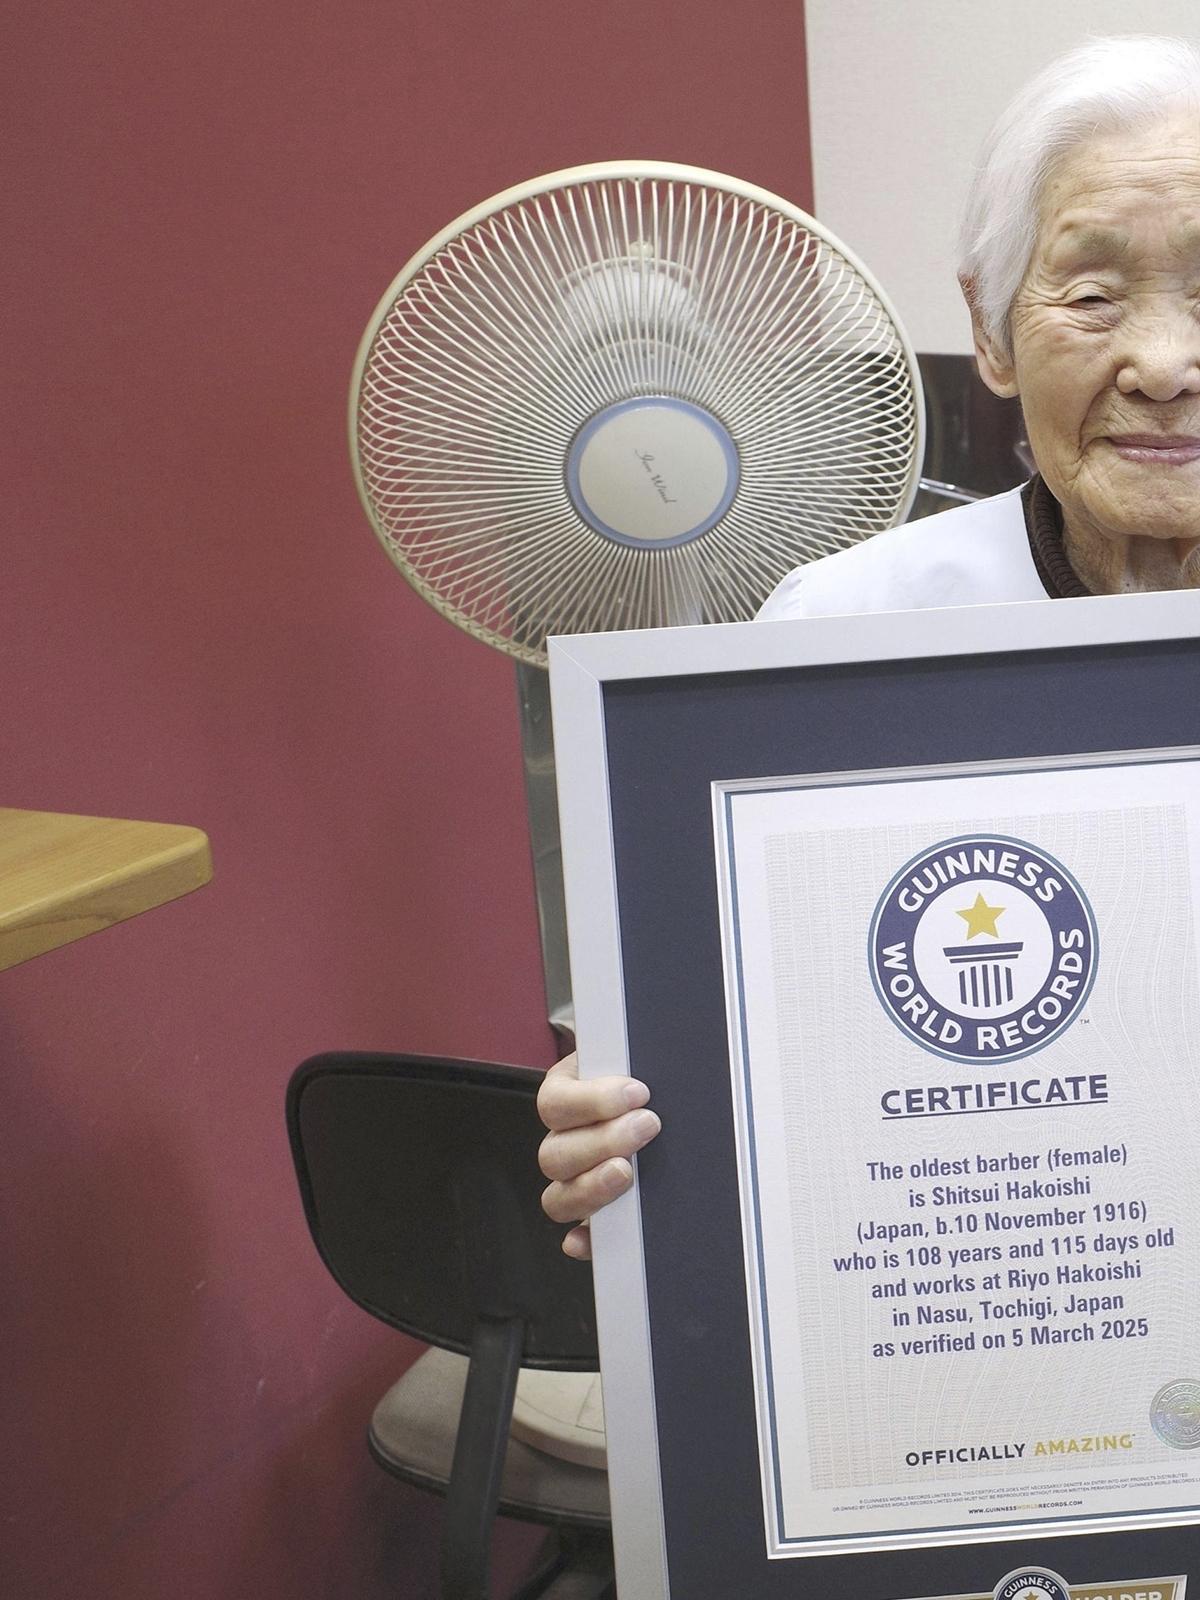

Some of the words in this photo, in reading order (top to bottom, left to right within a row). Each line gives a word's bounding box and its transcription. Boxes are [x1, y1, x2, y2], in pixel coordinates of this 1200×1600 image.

[898, 849, 1063, 912] GUINNESS
[882, 941, 962, 1043] WORLD
[976, 928, 1084, 1050] RECORDS
[881, 1074, 1108, 1114] CERTIFICATE
[866, 1161, 904, 1181] The
[909, 1157, 971, 1179] oldest
[976, 1151, 1041, 1174] barber
[1047, 1143, 1127, 1172] (female)
[908, 1188, 926, 1208] is
[931, 1182, 1000, 1207] Shitsui
[1006, 1175, 1091, 1201] Hakoishi
[857, 1220, 930, 1245] (Japan,
[935, 1213, 978, 1235] b.10
[984, 1207, 1087, 1232] November
[1092, 1200, 1147, 1224] 1916)
[833, 1251, 877, 1272] who
[882, 1249, 900, 1269] is
[906, 1246, 942, 1267] 108
[947, 1246, 1003, 1269] years
[1009, 1237, 1044, 1259] and
[1051, 1235, 1087, 1256] 115
[1093, 1233, 1139, 1255] days
[1145, 1227, 1175, 1249] old
[871, 1277, 907, 1299] and
[912, 1273, 976, 1296] works
[982, 1272, 1002, 1291] at
[1007, 1268, 1050, 1292] Riyo
[1056, 1259, 1142, 1285] Hakoishi
[892, 1307, 910, 1327] in
[916, 1305, 974, 1325] Nasu,
[978, 1296, 1058, 1321] Tochigi,
[1063, 1294, 1124, 1316] Japan
[872, 1342, 896, 1358] as
[900, 1331, 976, 1356] verified
[982, 1334, 1006, 1350] on
[1012, 1328, 1024, 1348] 5
[1030, 1322, 1095, 1346] March
[1101, 1317, 1149, 1340] 2025
[905, 1443, 1025, 1466] OFFICIALLY
[1034, 1434, 1133, 1456] AMAZING
[968, 1501, 1083, 1514] WWW.GUINNESSWORLDRECORDS.COM
[1004, 1576, 1058, 1598] GUINNESS
